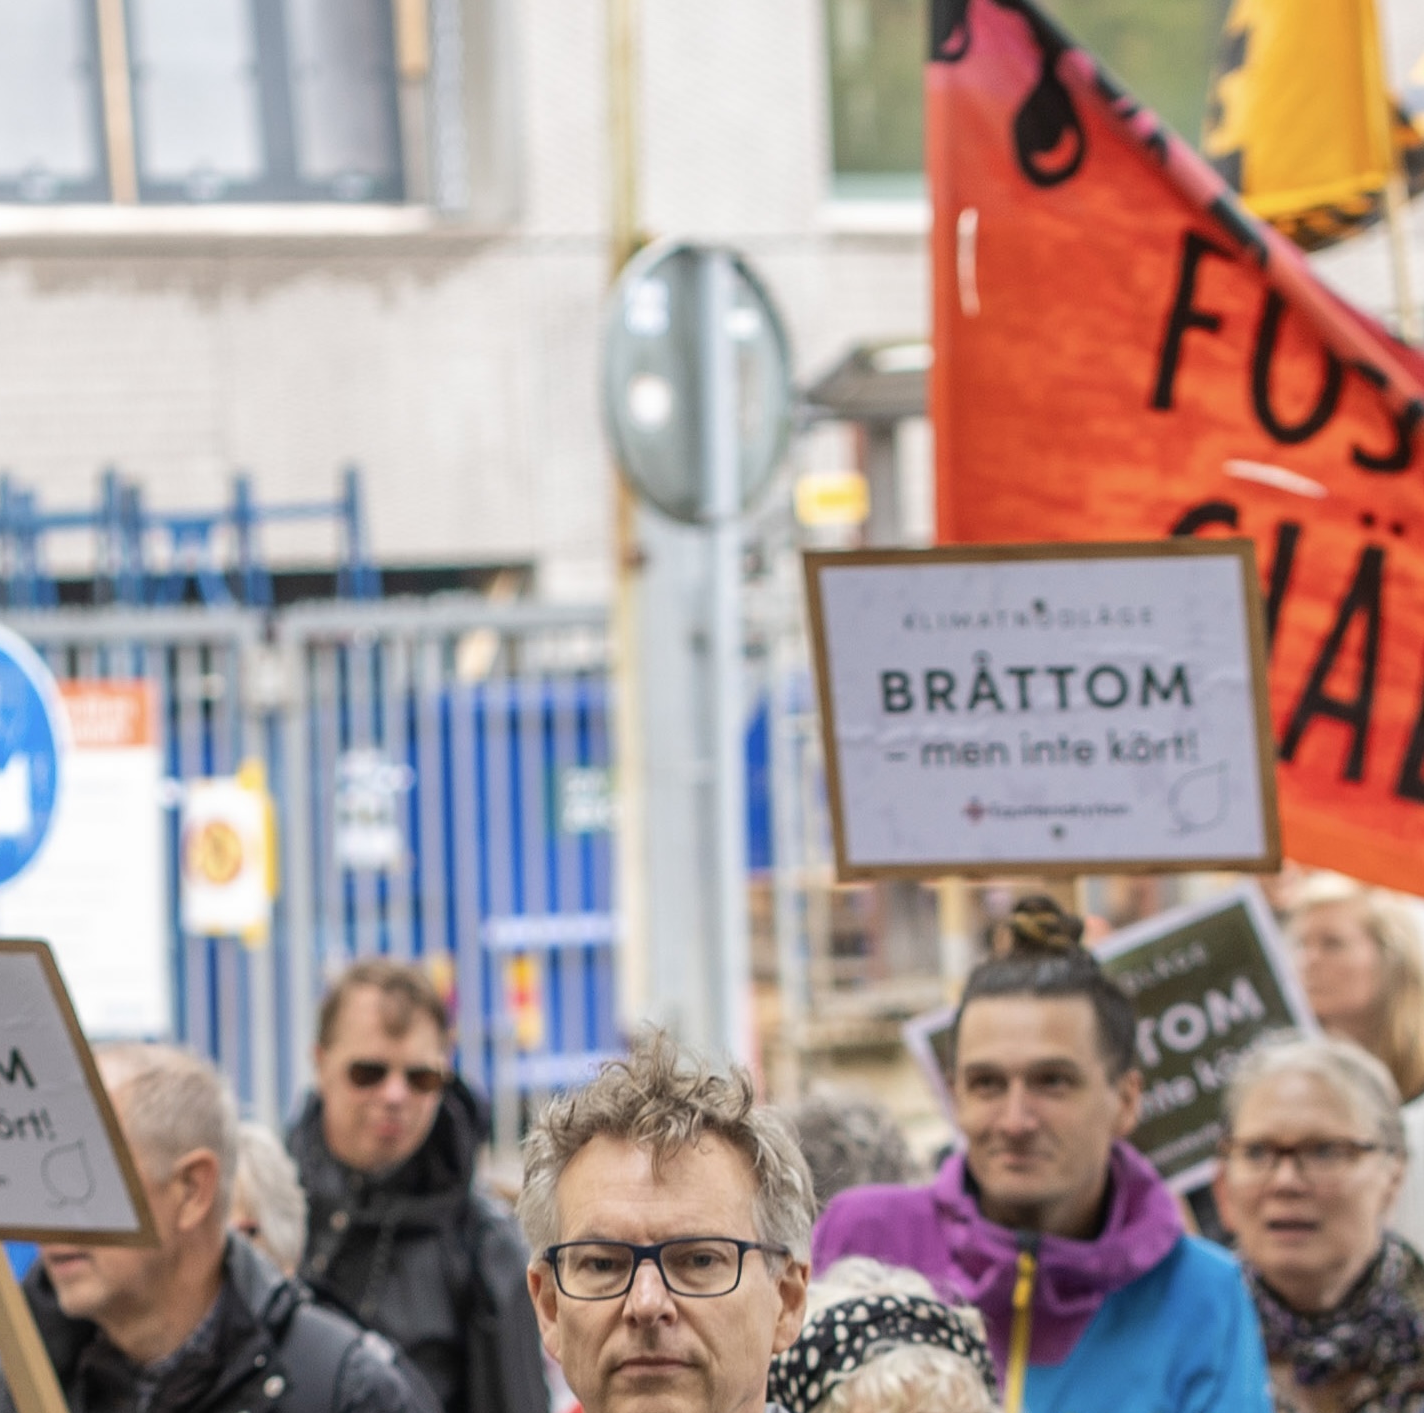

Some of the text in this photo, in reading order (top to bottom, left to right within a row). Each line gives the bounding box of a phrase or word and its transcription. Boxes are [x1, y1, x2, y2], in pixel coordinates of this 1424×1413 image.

[880, 650, 1193, 713] BRÅTTOM
[921, 740, 1010, 767] men
[1021, 730, 1096, 766] inte
[1106, 728, 1199, 764] kört!
